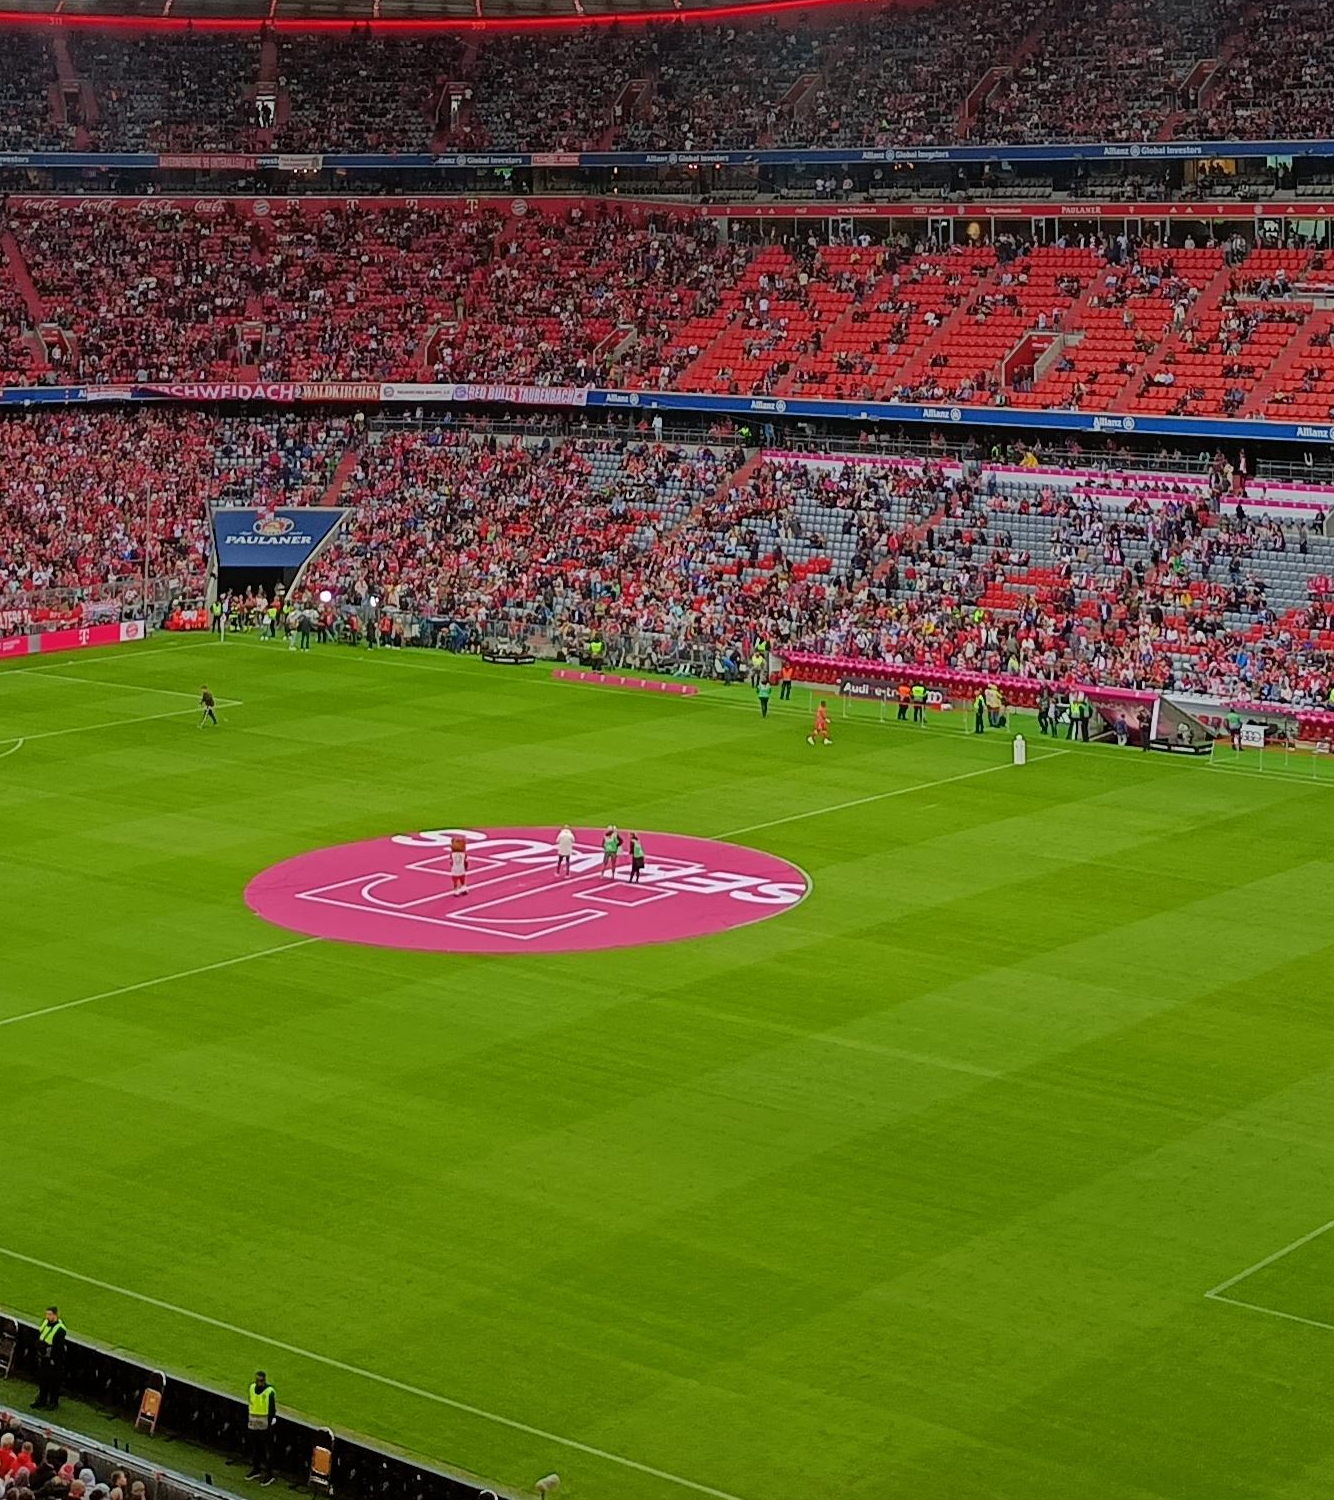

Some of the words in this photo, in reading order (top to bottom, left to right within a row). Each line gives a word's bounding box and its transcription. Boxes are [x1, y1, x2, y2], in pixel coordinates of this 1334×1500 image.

[895, 150, 917, 158] Global
[918, 150, 949, 159] Investors
[1104, 147, 1129, 155] Allianz
[1141, 146, 1165, 154] Global
[1061, 206, 1101, 214] PAULANER
[303, 384, 379, 399] WALDKIRCHEN
[469, 384, 486, 400] RED
[488, 385, 516, 401] BULLS
[606, 393, 628, 403] Allianz
[751, 400, 775, 410] Allianz
[923, 408, 949, 418] Allianz
[1093, 417, 1122, 427] Allianz
[1296, 427, 1328, 437] Allianz
[225, 535, 312, 545] PAULANER
[843, 682, 868, 696] Audi
